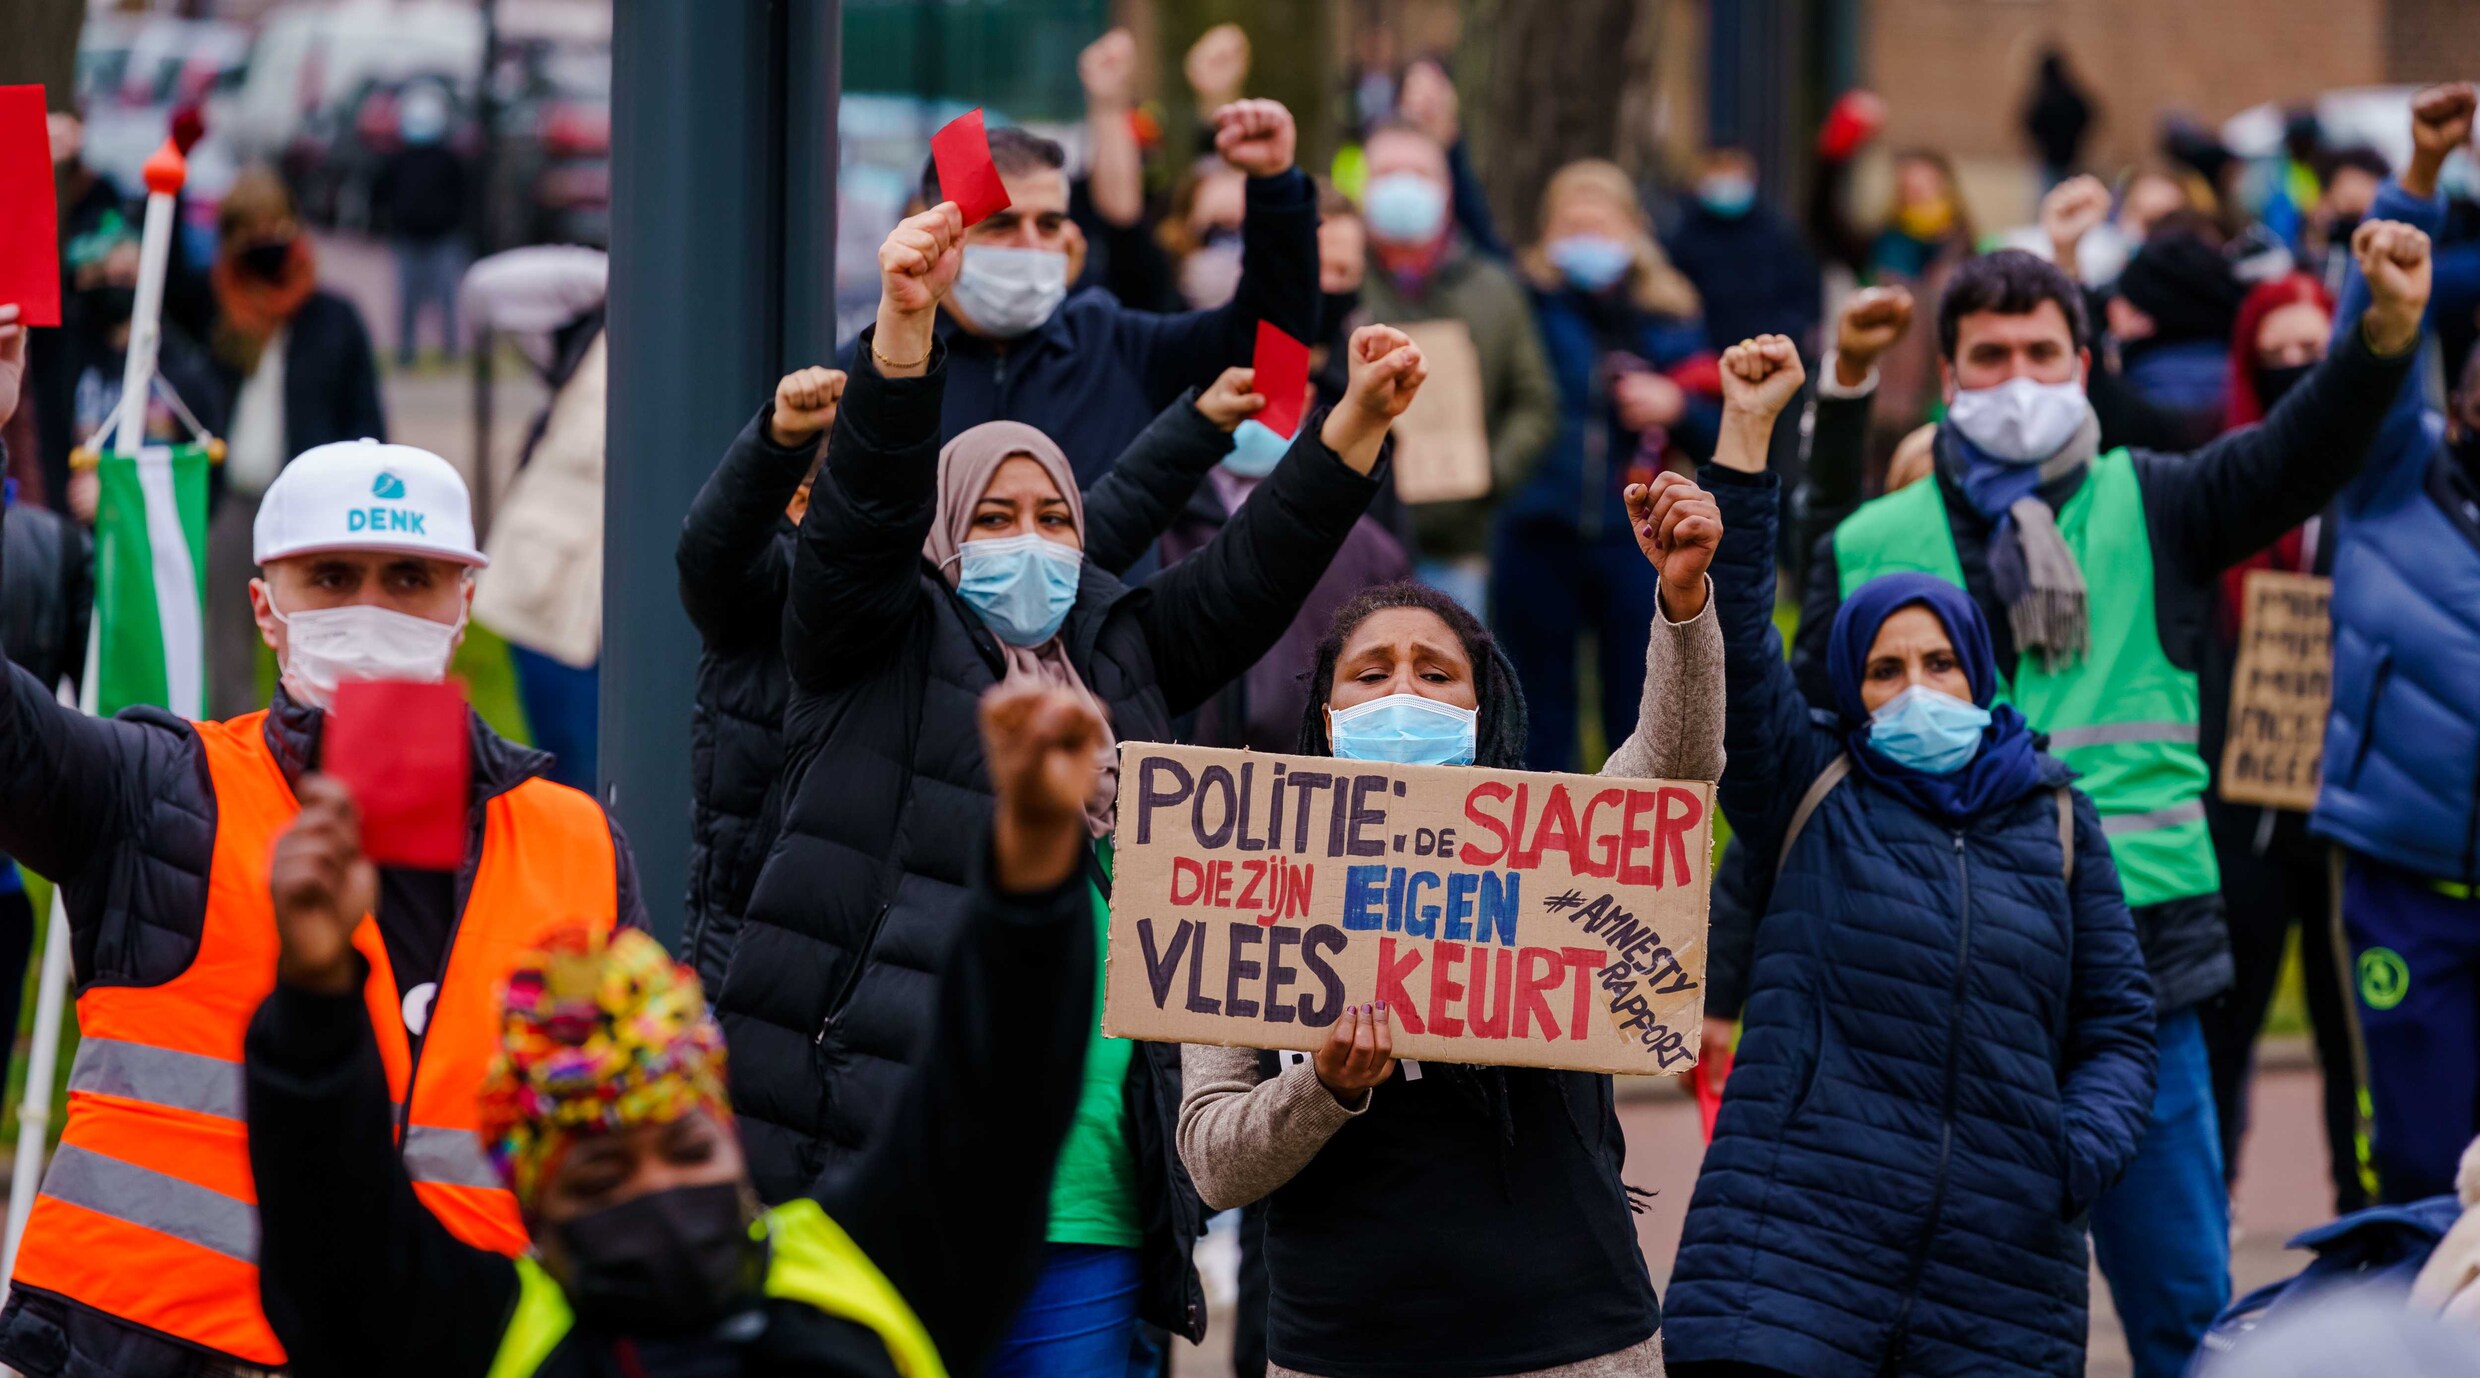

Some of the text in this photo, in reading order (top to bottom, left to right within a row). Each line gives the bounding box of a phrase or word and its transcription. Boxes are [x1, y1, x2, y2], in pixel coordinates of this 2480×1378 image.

[347, 507, 426, 535] DENK
[1415, 827, 1457, 858] DE
[1459, 781, 1703, 892] SLAGER
[1343, 864, 1520, 946] EIGEN
[1543, 888, 1698, 994] #AMNESTY
[1137, 918, 1607, 1042] VLEES KEURT
[1597, 960, 1696, 1069] RAPPORT
